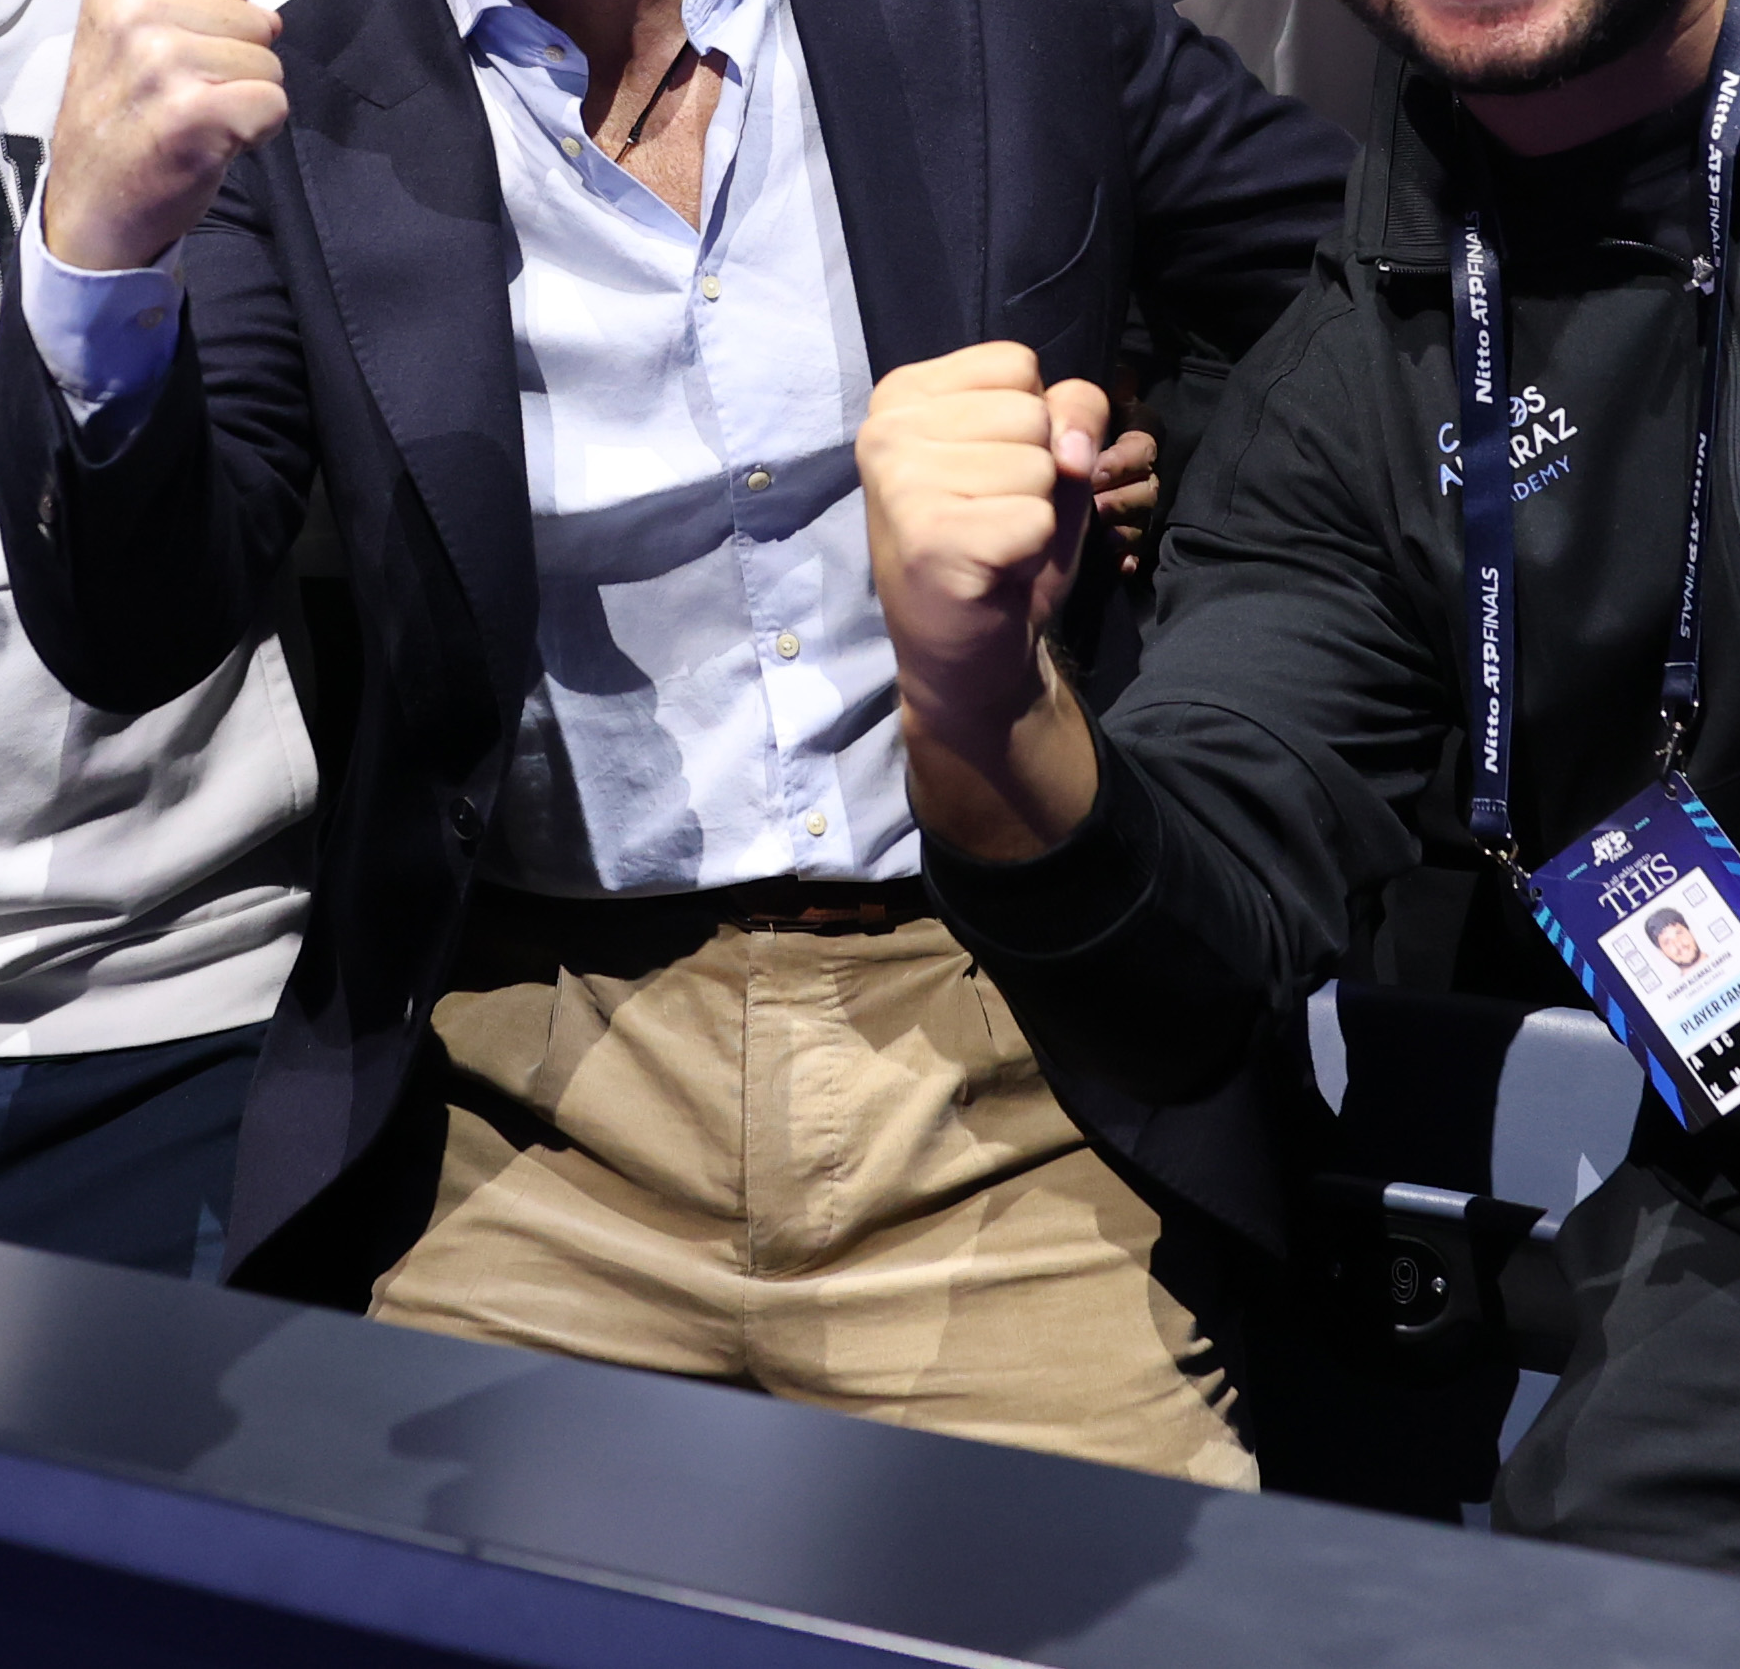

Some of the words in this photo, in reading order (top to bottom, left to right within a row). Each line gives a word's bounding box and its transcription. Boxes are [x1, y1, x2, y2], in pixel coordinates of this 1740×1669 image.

[1710, 70, 1740, 140] Nitto
[1474, 330, 1494, 404] Nitto
[1484, 698, 1501, 773] Nitto
[1598, 852, 1678, 920] THIS
[1679, 1000, 1723, 1036] PLAYER
